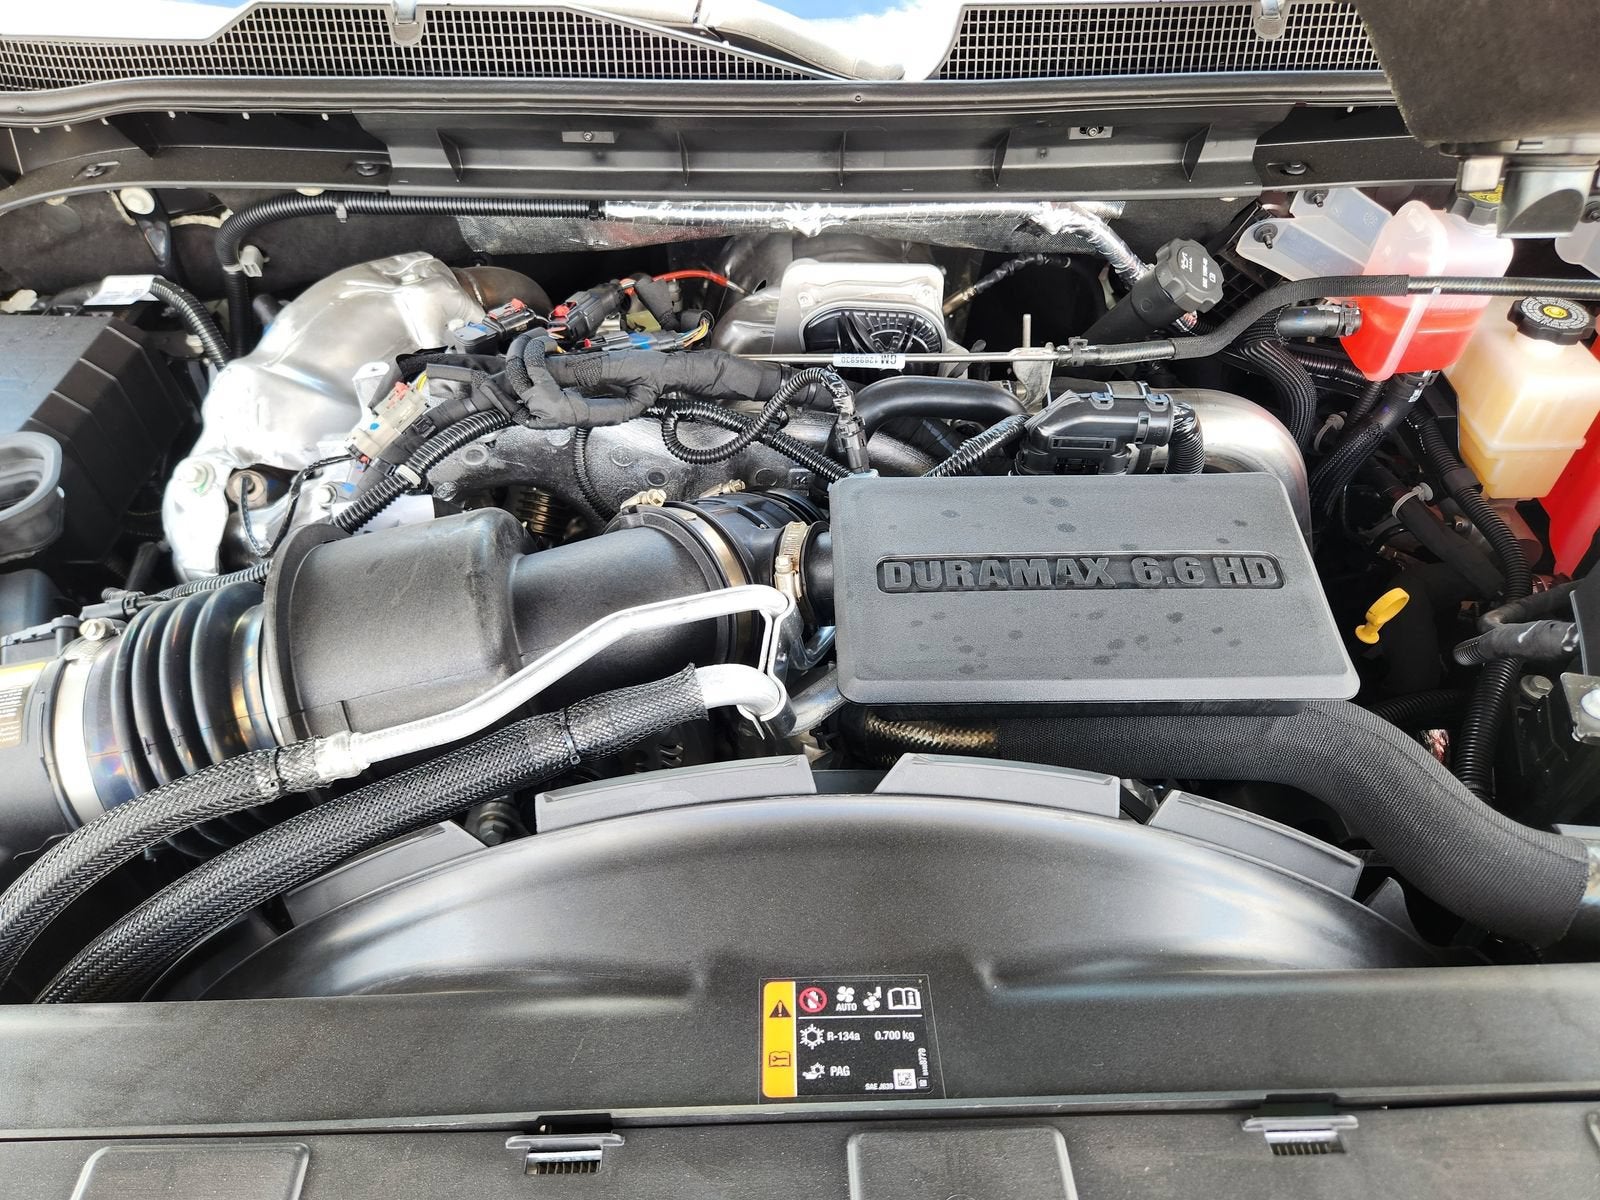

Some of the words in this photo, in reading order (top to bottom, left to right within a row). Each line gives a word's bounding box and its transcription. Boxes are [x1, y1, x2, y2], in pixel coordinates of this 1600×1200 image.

[881, 354, 897, 365] GM
[884, 557, 1117, 590] DURAMAX
[1131, 556, 1206, 586] 6.6
[1212, 556, 1279, 585] HD
[836, 1003, 857, 1012] AUTO
[827, 1031, 861, 1041] R-134a
[874, 1030, 901, 1041] 0.700
[902, 1030, 915, 1042] kg
[830, 1065, 850, 1077] PAG
